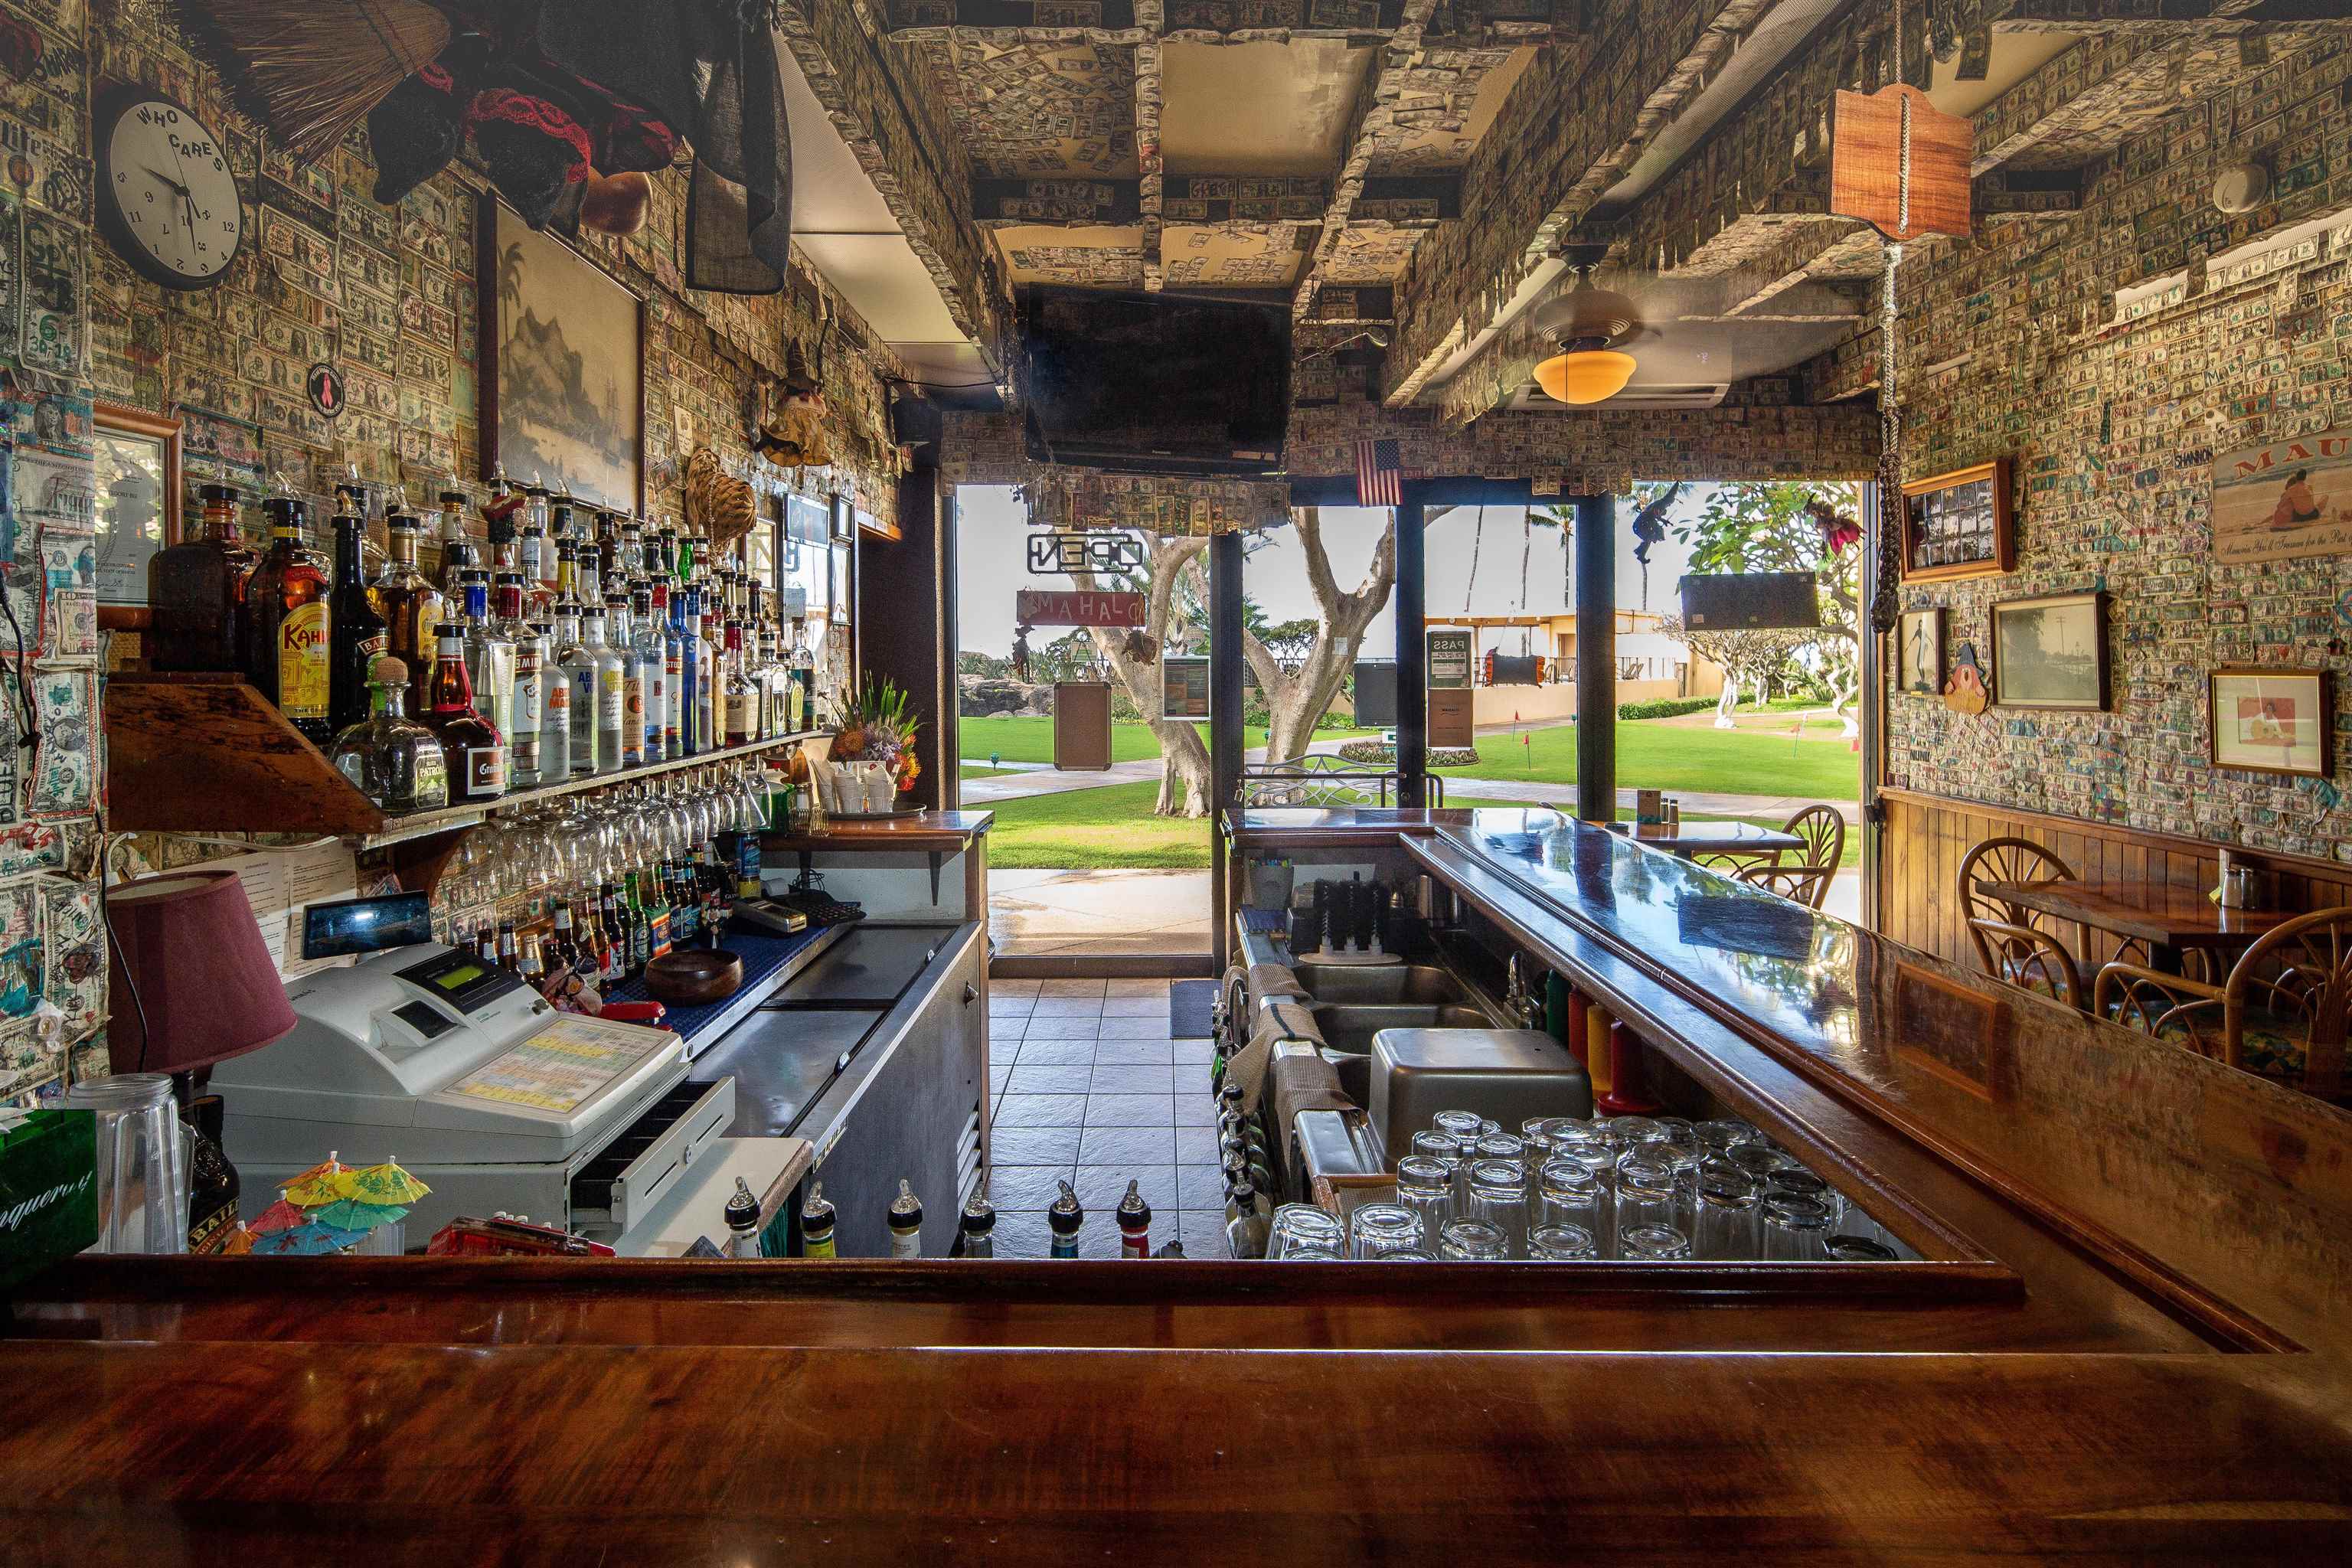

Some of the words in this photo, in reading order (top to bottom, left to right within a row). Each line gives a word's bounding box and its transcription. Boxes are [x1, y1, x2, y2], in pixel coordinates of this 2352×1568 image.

[136, 106, 178, 128] WHO
[168, 133, 223, 172] CARES
[116, 172, 127, 183] 5
[145, 191, 153, 203] 9
[129, 211, 143, 223] 11
[162, 224, 170, 235] 7
[223, 220, 235, 233] 12
[153, 244, 160, 255] 1
[220, 251, 228, 261] 4
[176, 258, 185, 270] 2
[1037, 595, 1143, 621] MAHALO
